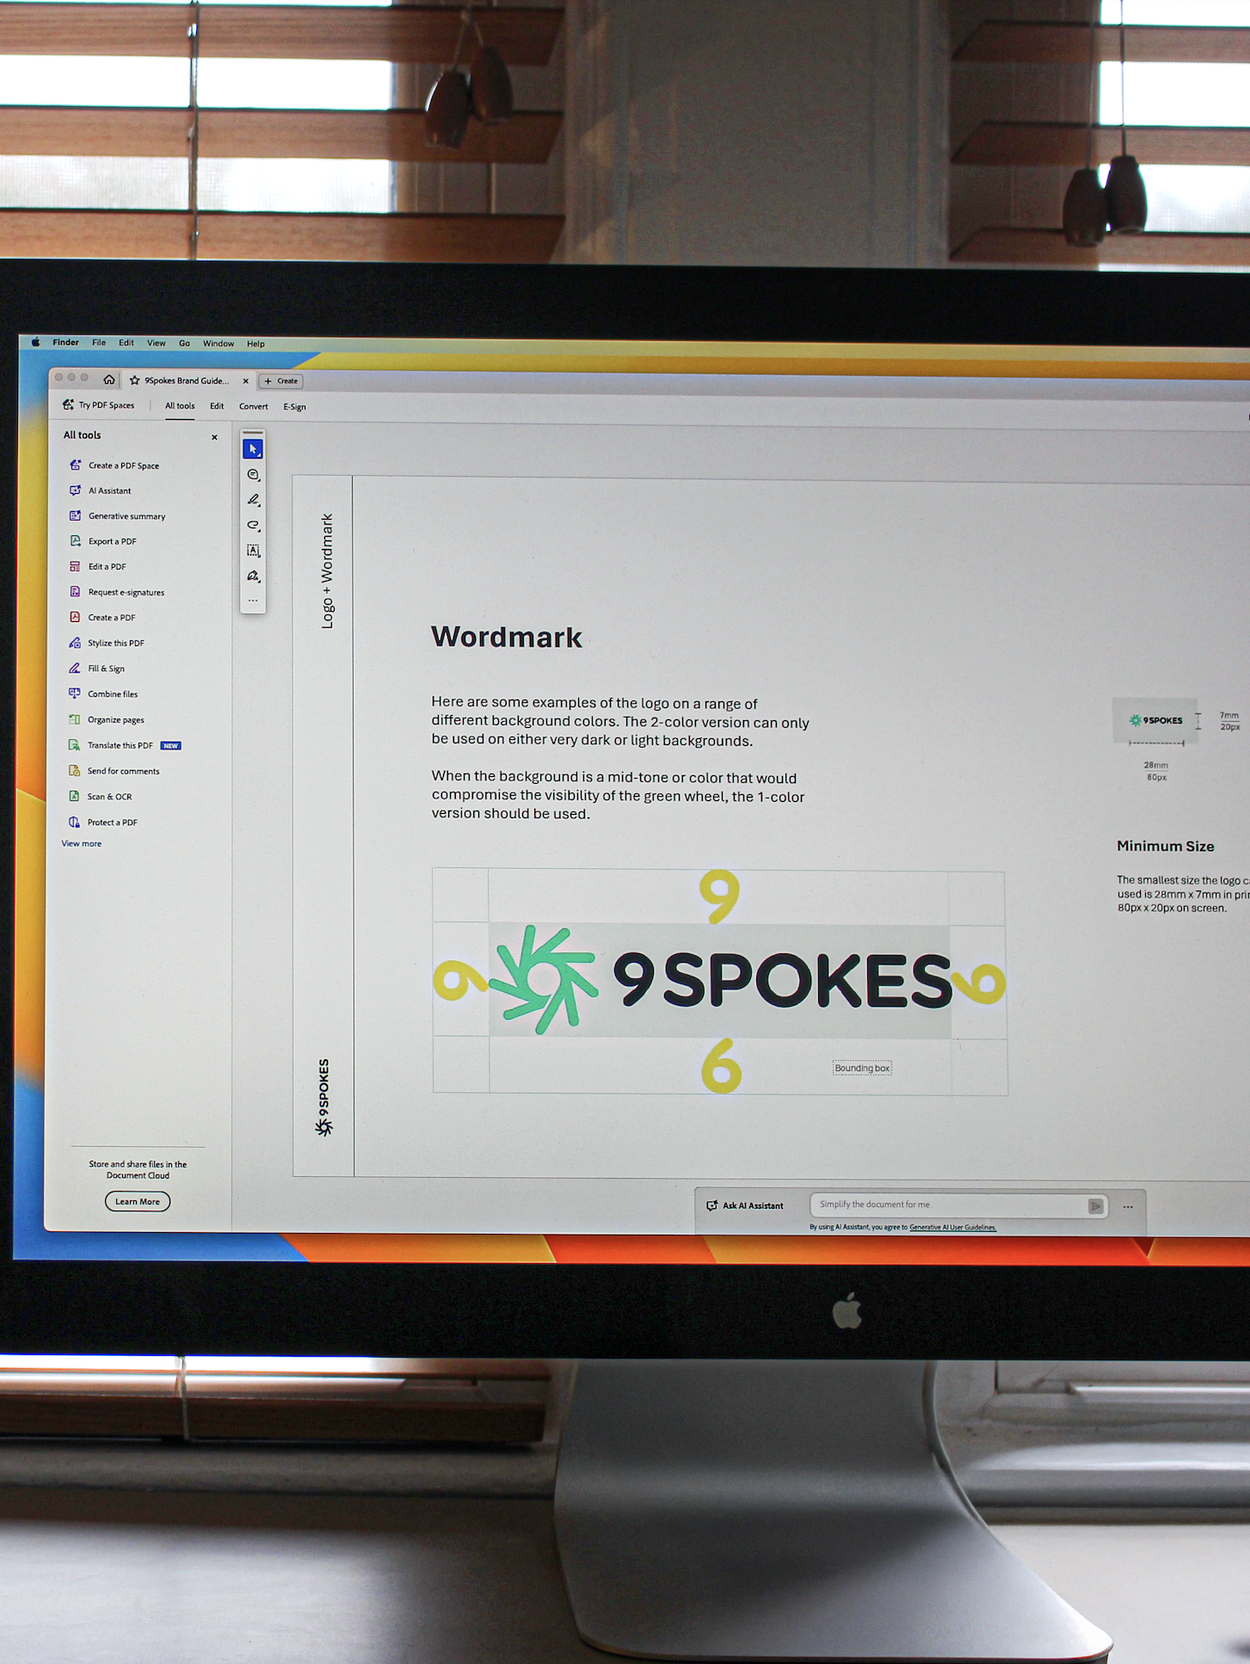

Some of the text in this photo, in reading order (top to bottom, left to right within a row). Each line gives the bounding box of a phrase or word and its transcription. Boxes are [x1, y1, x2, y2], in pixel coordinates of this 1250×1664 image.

[52, 338, 80, 346] Finder
[92, 338, 106, 346] File
[119, 338, 134, 346] Edit
[147, 339, 166, 347] View
[179, 339, 191, 347] Go
[247, 340, 265, 349] Help
[144, 376, 228, 386] 9Spokes Brand Guide...
[79, 401, 135, 410] Try PDF Spaces
[176, 402, 196, 410] tools
[210, 402, 224, 410] Edit
[239, 402, 269, 410] Convert
[283, 403, 307, 413] E-Sign
[63, 430, 101, 440] All tools
[88, 461, 113, 469] Create
[120, 462, 136, 470] PDF
[137, 462, 160, 471] Space
[98, 487, 132, 495] Assistant
[88, 512, 166, 522] Generative summary
[321, 513, 333, 583] Wordmark
[88, 588, 165, 598] Request e-signatures
[321, 597, 336, 629] Logo
[430, 625, 583, 648] Wordmark
[88, 639, 145, 649] Stylize this PDF
[88, 690, 138, 698] Combine files
[432, 695, 758, 712] Here are some examples of the logo on a range of
[1220, 711, 1239, 719] 7mm
[87, 715, 145, 726] Organize pages
[431, 714, 810, 732] different background colors. The 2-color version can only
[1143, 716, 1183, 725] 9SPOKES
[1220, 723, 1240, 732] 20px
[87, 741, 153, 750] Translate this PDF
[432, 733, 753, 749] be used on either very dark or light backgrounds.
[1144, 761, 1169, 769] 28mm
[87, 766, 160, 776] Send for comments
[431, 770, 797, 785] When the background is a mid-tone or color that would
[1147, 773, 1167, 782] 80px
[432, 788, 805, 804] compromise the visibility of the green wheel, the 1-color
[431, 807, 590, 820] version should be used.
[88, 818, 114, 826] Protect
[122, 818, 138, 826] PDF
[61, 840, 80, 848] View
[1117, 840, 1215, 852] Minimum Size
[1117, 875, 1135, 885] The
[1137, 875, 1179, 885] smallest
[1181, 875, 1200, 885] size
[1202, 876, 1218, 885] the
[1220, 876, 1241, 887] logo
[699, 868, 740, 925] 9
[1117, 889, 1142, 899] used
[1144, 891, 1153, 899] is
[1154, 890, 1186, 899] 28mm
[1195, 889, 1221, 899] 7mm
[1223, 890, 1232, 899] in
[1117, 903, 1142, 914] 80px
[1151, 903, 1175, 914] 20px
[1176, 904, 1189, 913] on
[1191, 904, 1227, 913] screen.
[614, 952, 952, 1008] 9SPOKES
[835, 1064, 890, 1074] Bounding box
[319, 1058, 329, 1116] 9SPOKES
[106, 1171, 170, 1180] Document Cloud
[139, 1198, 160, 1206] More
[722, 1201, 784, 1210] Ask AI Assistant
